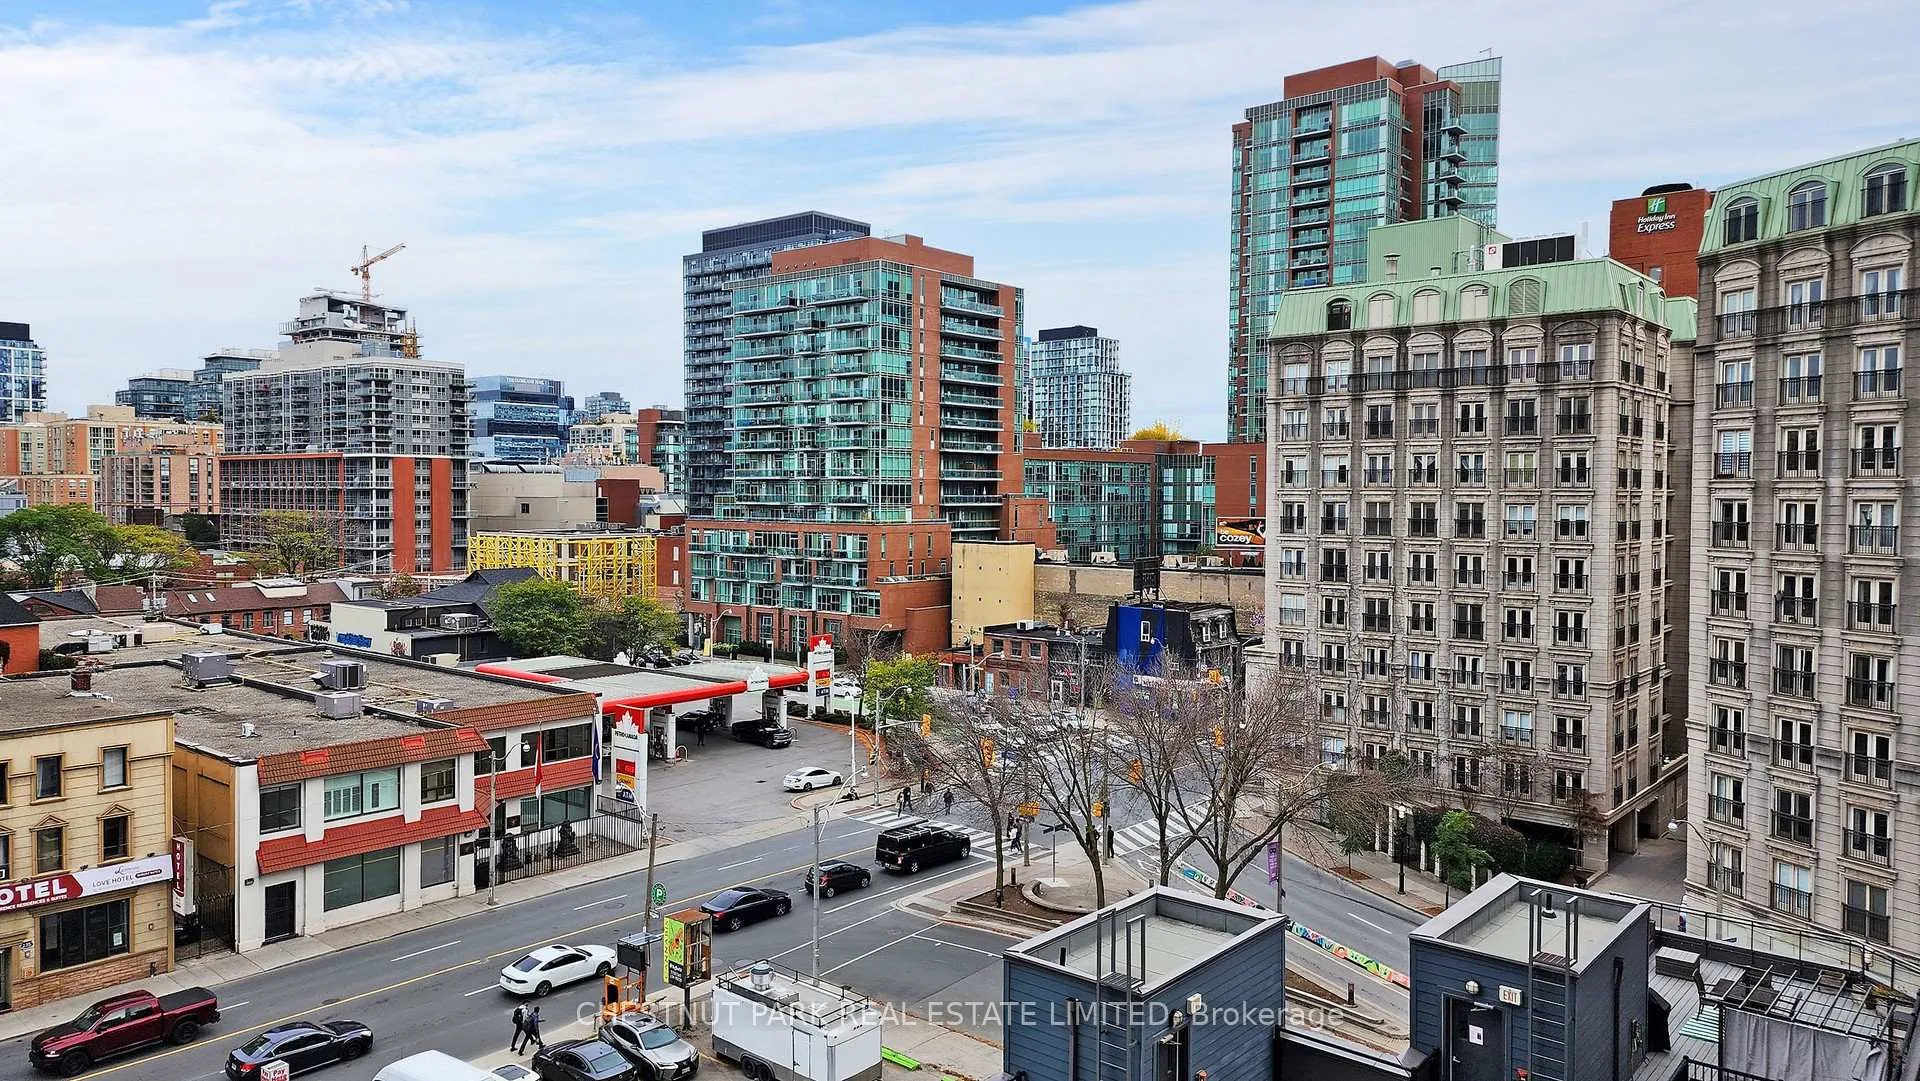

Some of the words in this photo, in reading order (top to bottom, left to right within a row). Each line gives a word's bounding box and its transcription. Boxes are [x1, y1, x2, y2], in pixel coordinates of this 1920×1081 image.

[1637, 214, 1664, 223] Holiday
[1637, 221, 1676, 233] Express
[1219, 535, 1252, 544] cozey
[92, 880, 109, 888] LOVE
[112, 875, 133, 883] HOTEL
[0, 879, 67, 906] OTEL
[1503, 990, 1517, 1003] EXIT
